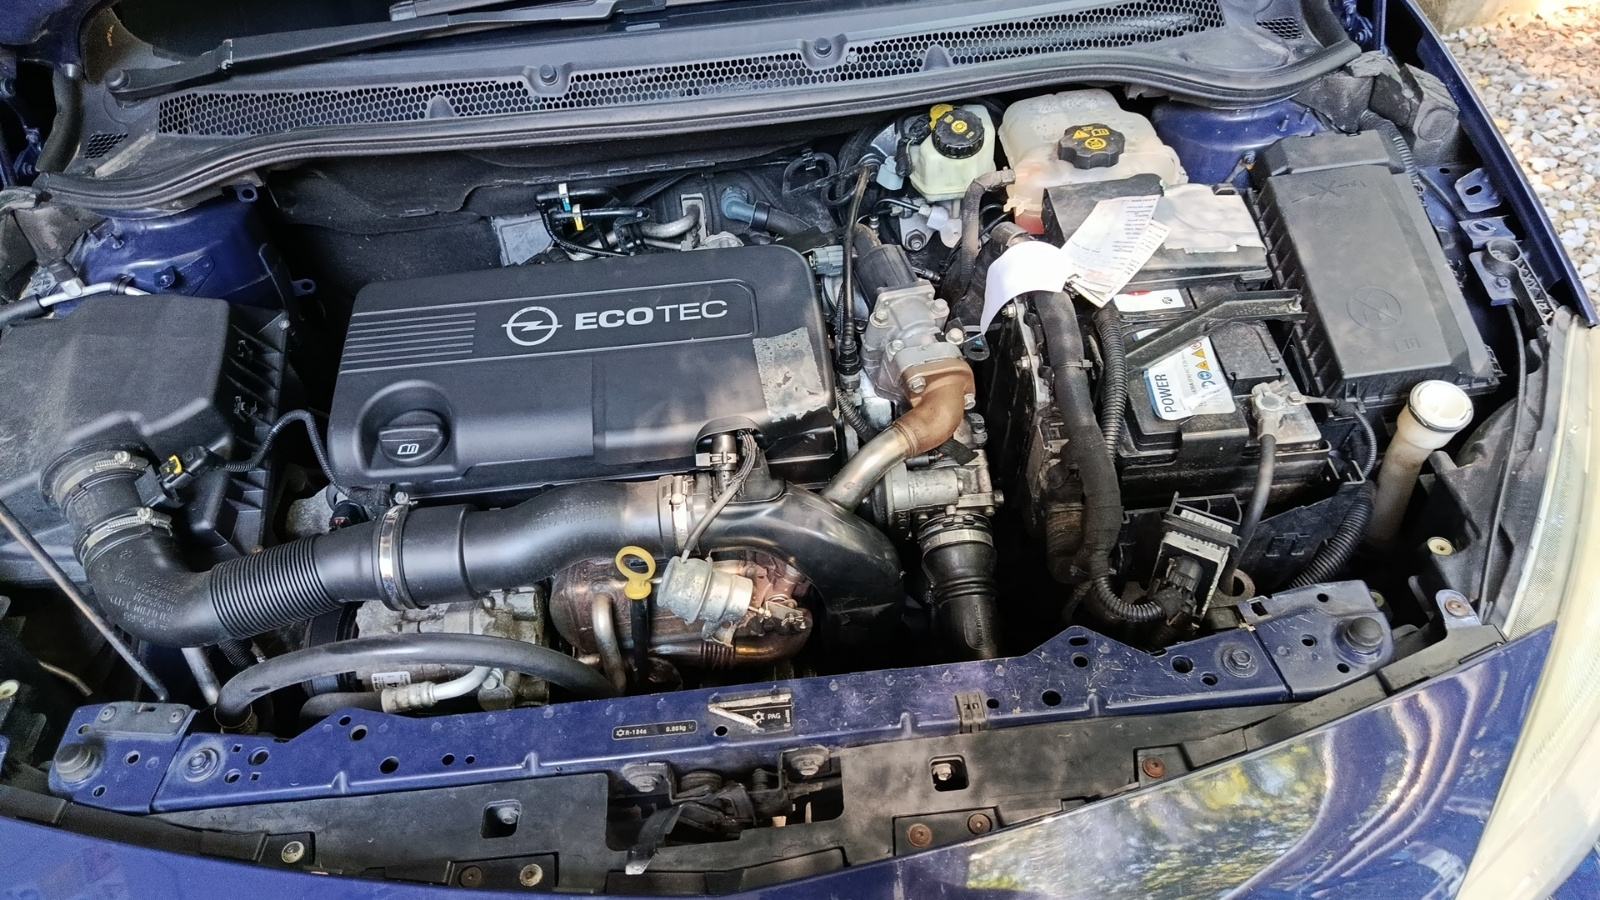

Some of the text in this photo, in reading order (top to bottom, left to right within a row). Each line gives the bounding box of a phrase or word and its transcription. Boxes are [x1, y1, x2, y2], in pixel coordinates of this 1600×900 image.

[574, 299, 729, 332] ECOTEC
[1154, 373, 1177, 413] POWER
[767, 712, 781, 720] PAG
